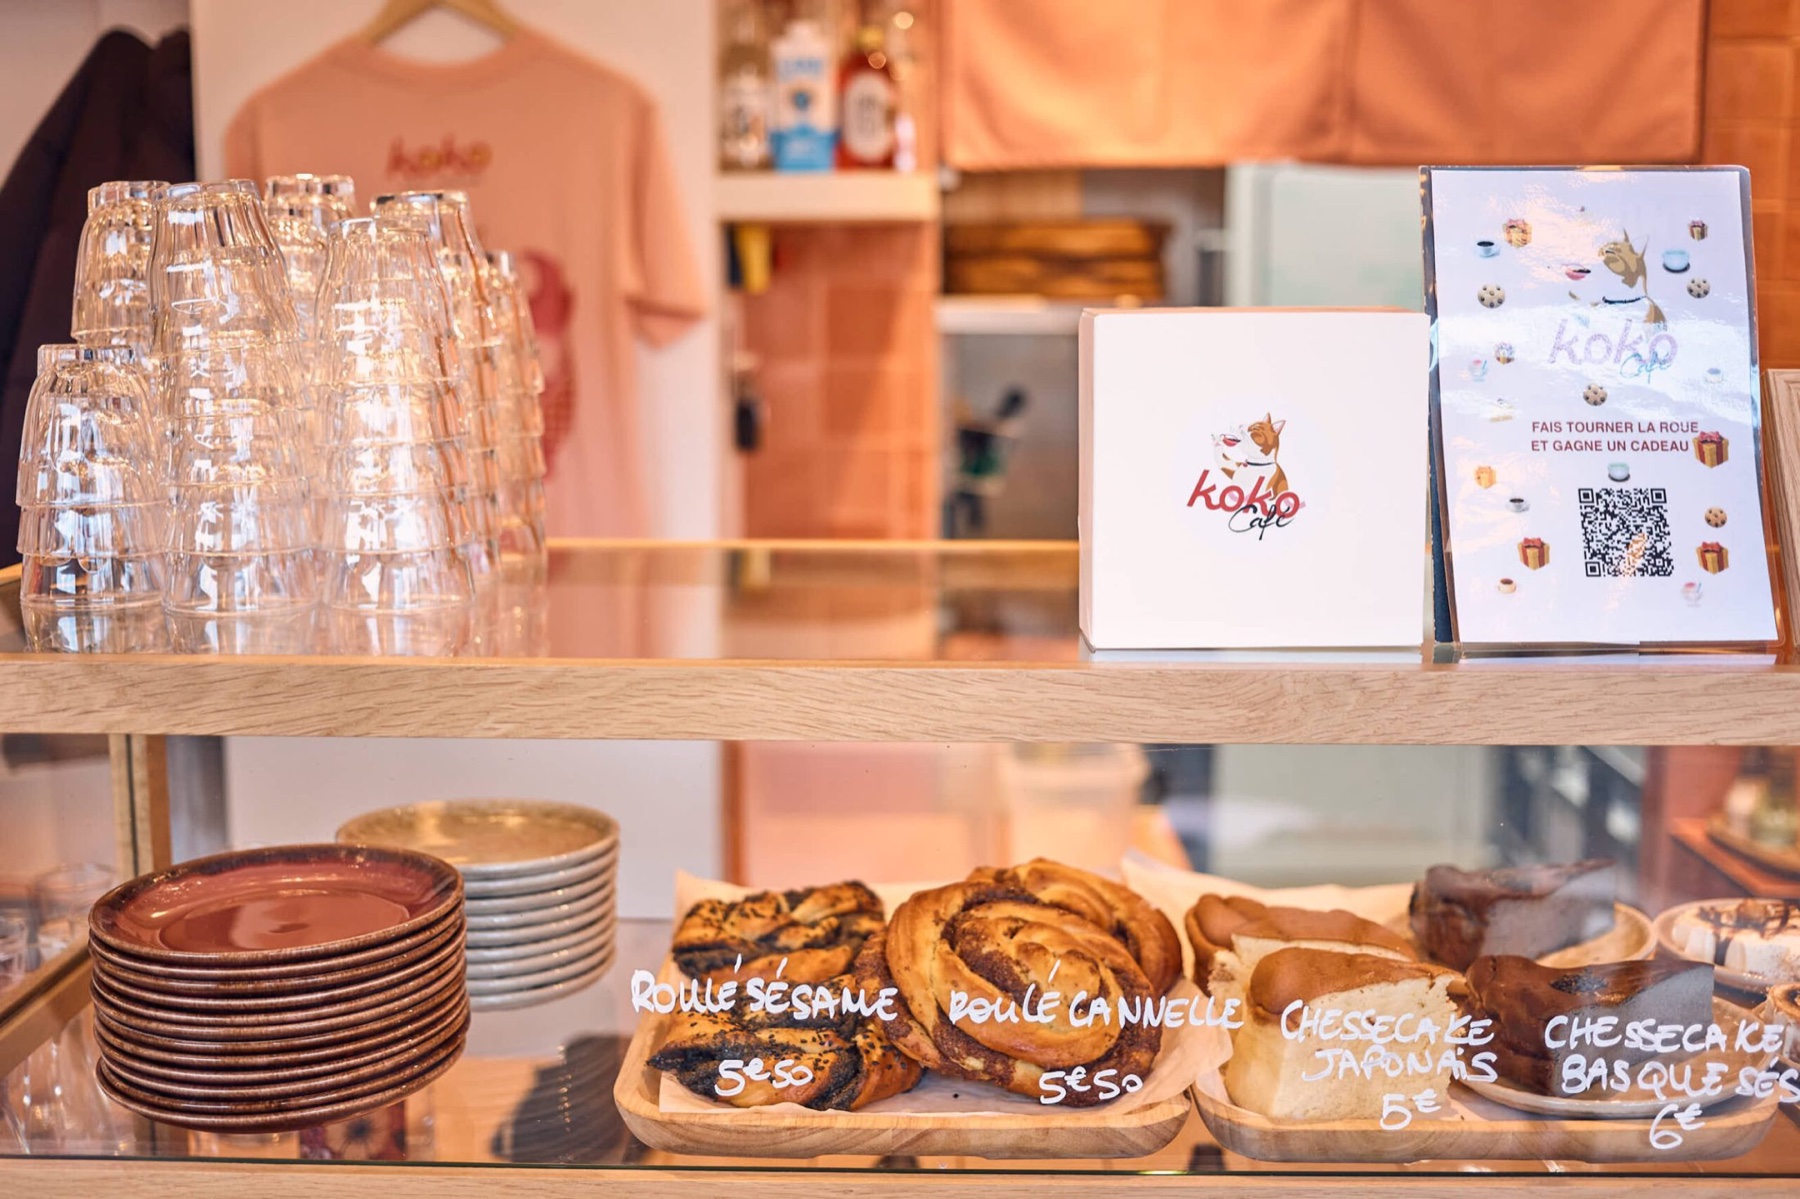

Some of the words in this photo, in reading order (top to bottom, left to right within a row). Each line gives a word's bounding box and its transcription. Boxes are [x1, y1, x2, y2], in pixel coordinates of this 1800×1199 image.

[1548, 319, 1678, 365] koko
[1531, 440, 1548, 452] ET
[1552, 440, 1603, 452] GAGNE
[1607, 440, 1627, 452] UN
[1630, 440, 1689, 452] CADEAU
[1532, 421, 1563, 433] FAIS
[1566, 421, 1634, 433] TOURNER
[1638, 421, 1656, 433] LA
[1659, 421, 1699, 433] ROUE
[1186, 469, 1300, 518] koko
[1228, 504, 1294, 541] Café
[631, 953, 738, 1013] ROULÉ
[746, 957, 899, 1021] SÉSAME
[1068, 990, 1245, 1029] CANNELLE
[1280, 999, 1495, 1046] CHESSECAKE
[1544, 1015, 1784, 1053] CHESSECAKE
[1561, 1053, 1729, 1101] BASQUE
[1379, 1088, 1442, 1131] 5€
[1649, 1103, 1706, 1150] 6€
